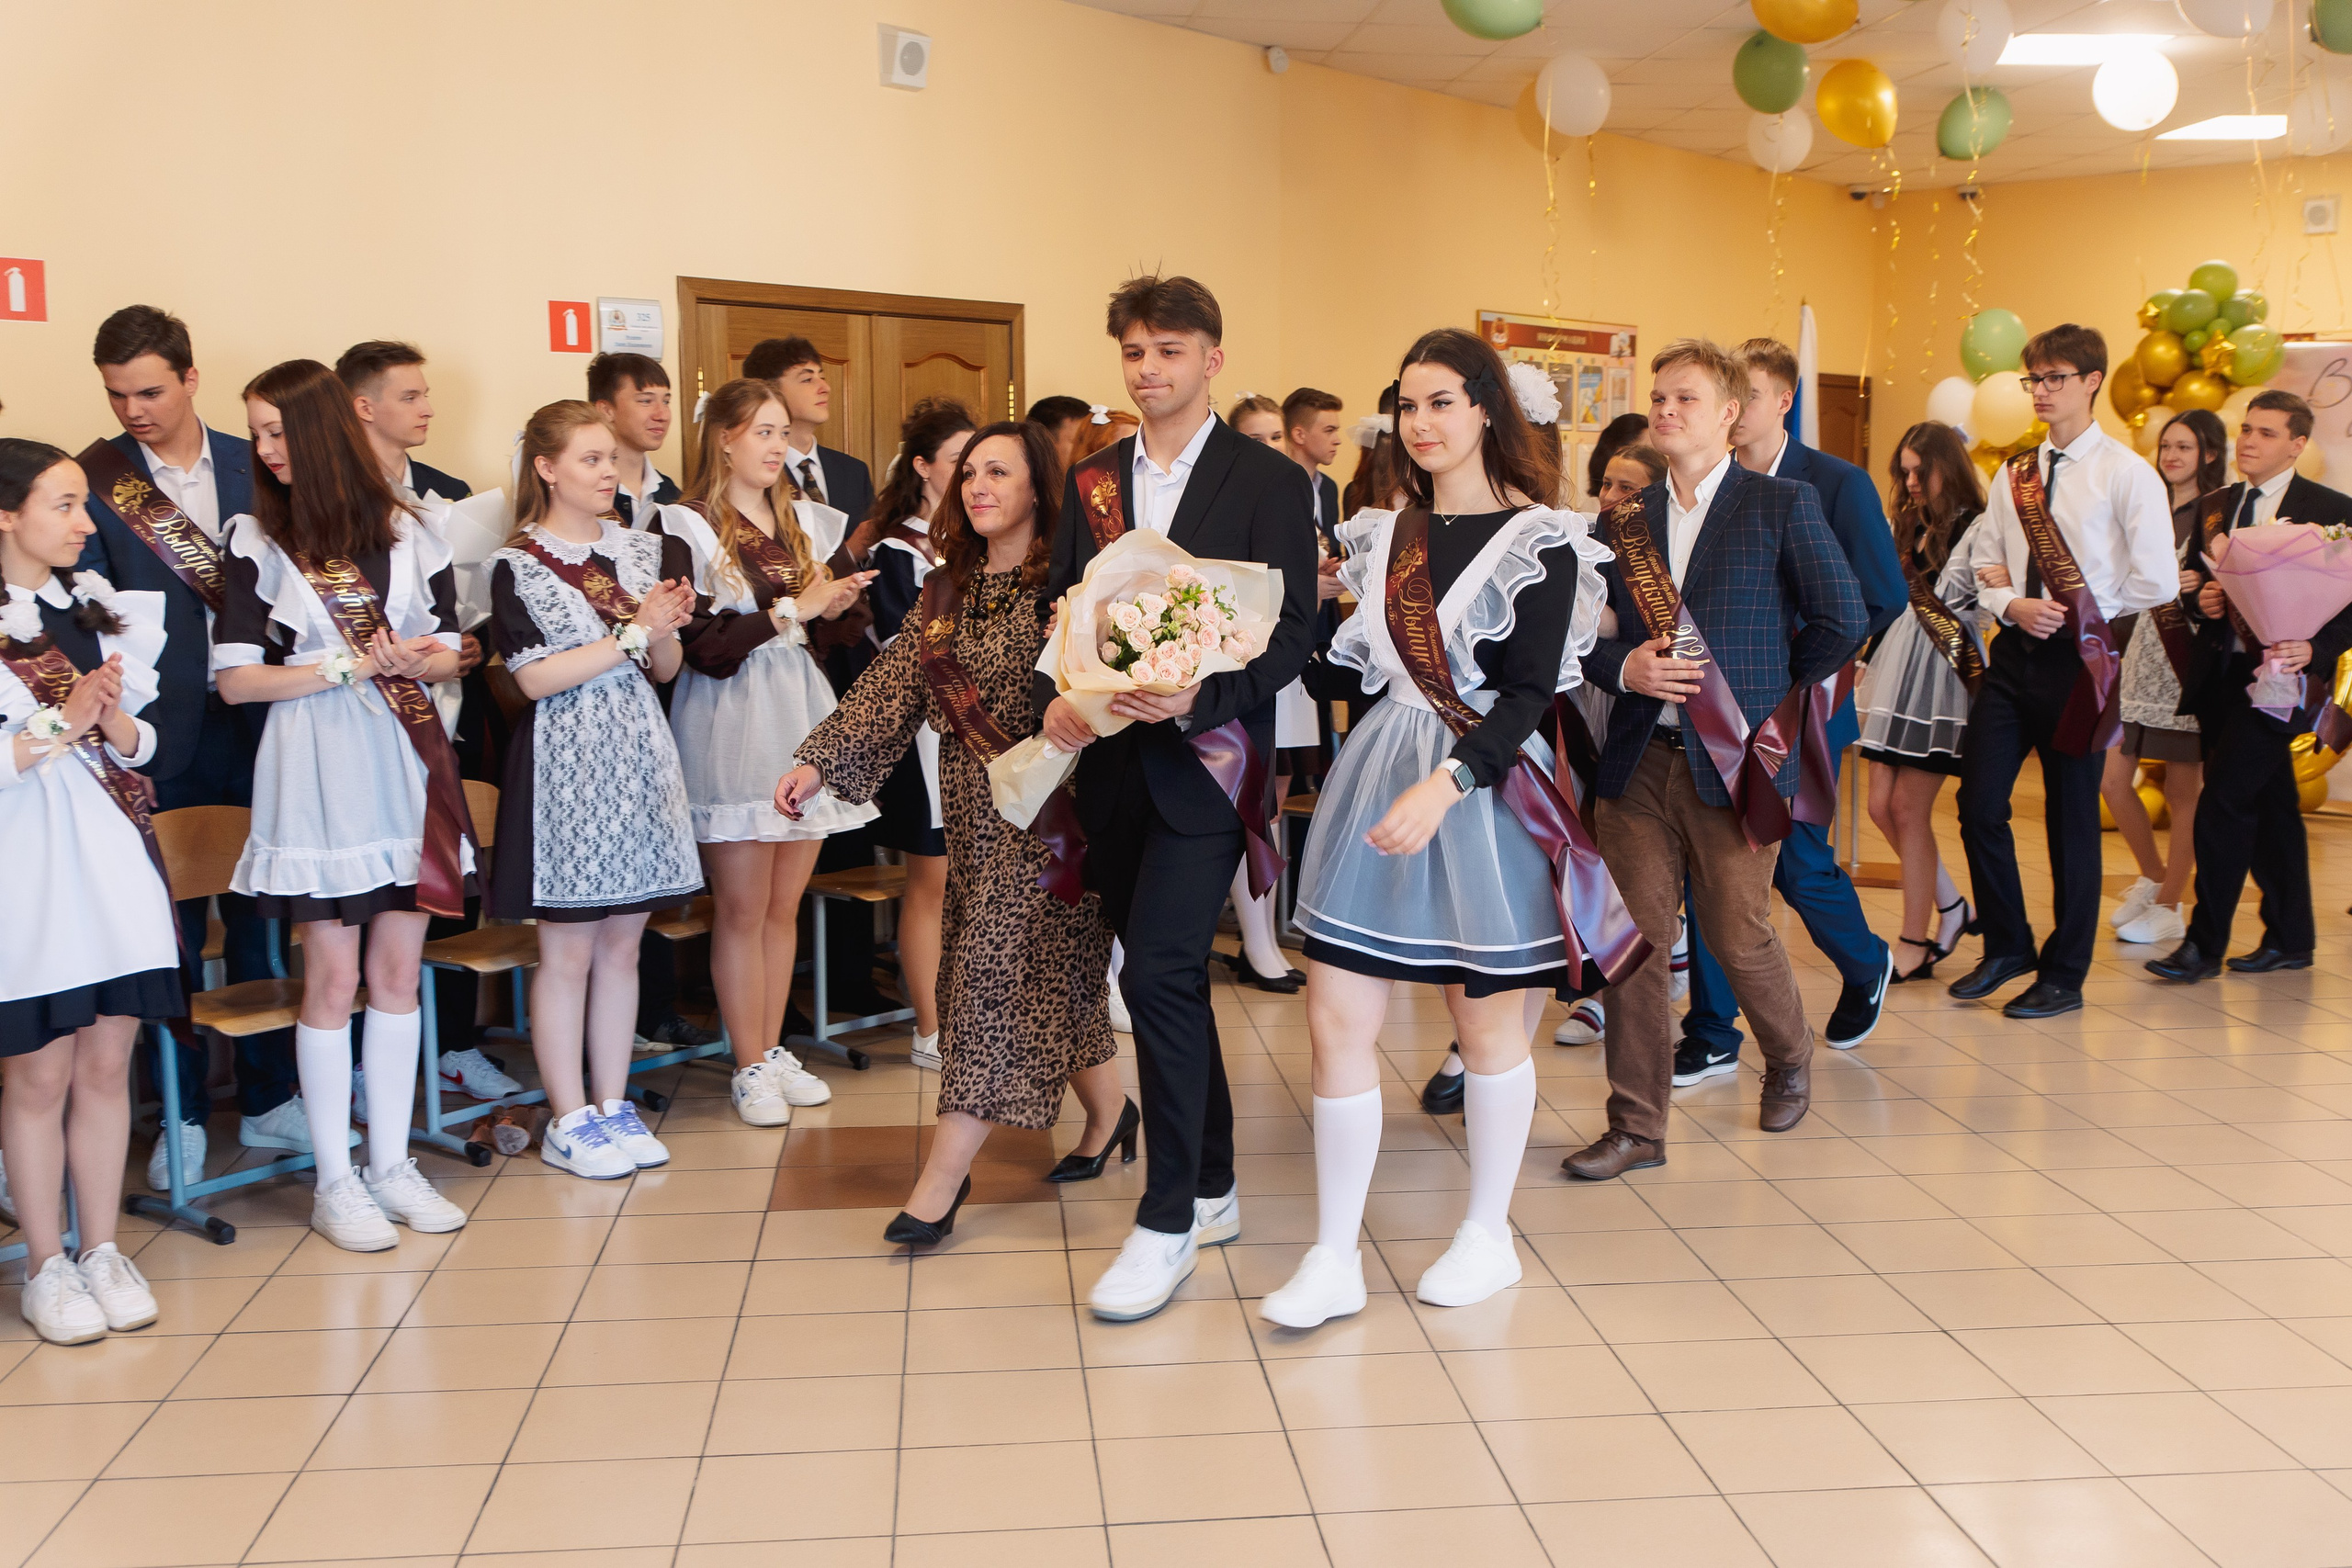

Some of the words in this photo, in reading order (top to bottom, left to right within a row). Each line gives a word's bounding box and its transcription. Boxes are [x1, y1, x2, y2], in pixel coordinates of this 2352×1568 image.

[141, 500, 226, 594] Выпускн
[1619, 519, 1676, 630] Выпускник
[1659, 573, 1678, 604] Герман
[2046, 556, 2086, 592] 2024
[1388, 605, 1399, 626] «Б»
[389, 681, 435, 725] 2024
[937, 683, 1000, 761] руководитель
